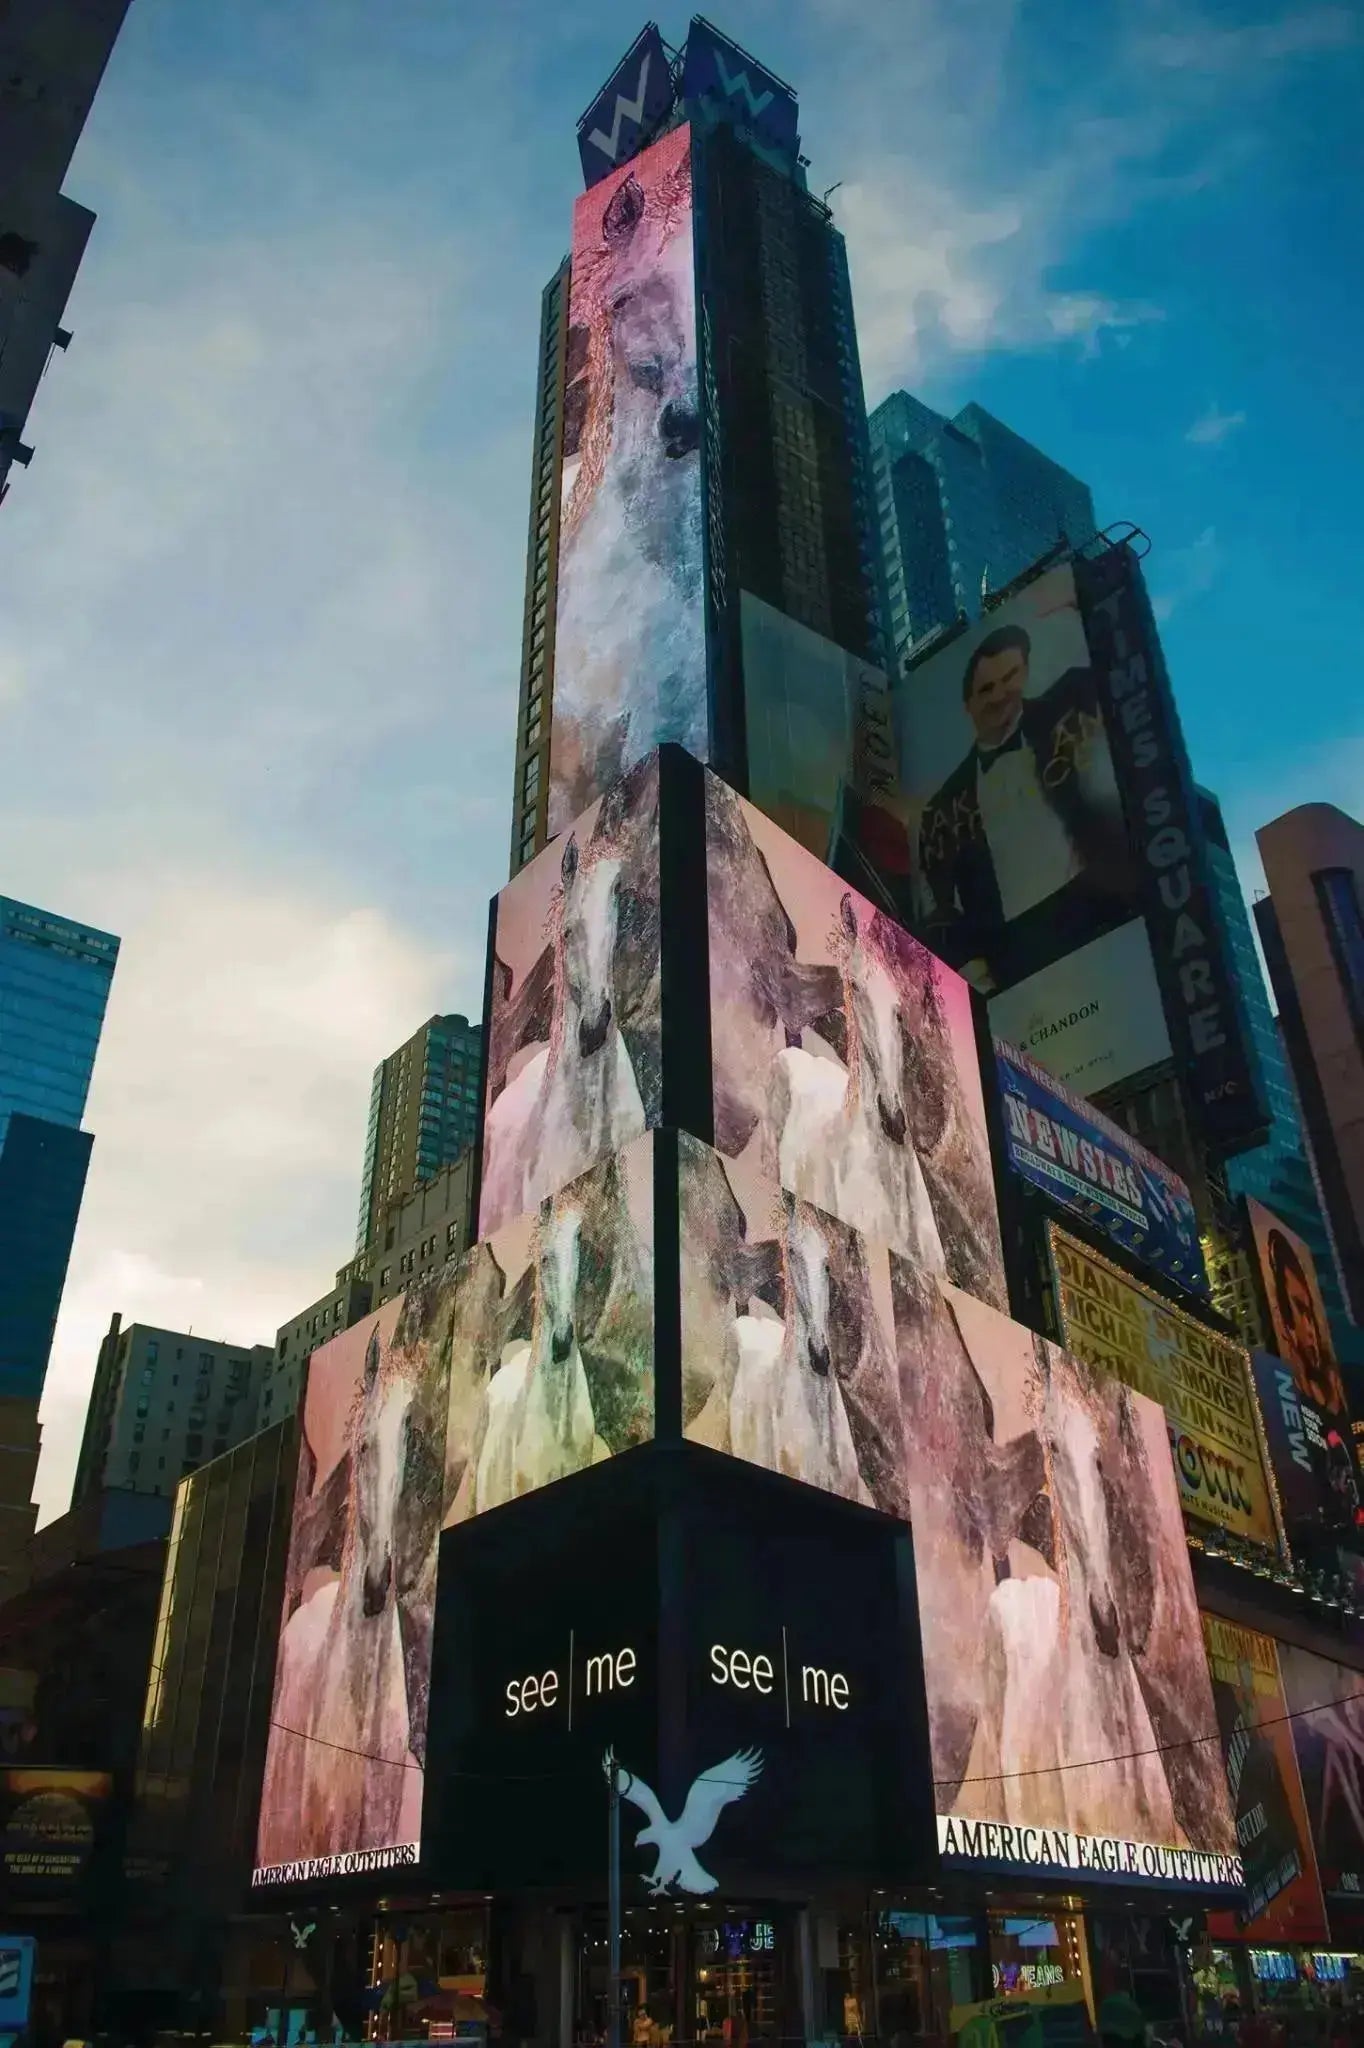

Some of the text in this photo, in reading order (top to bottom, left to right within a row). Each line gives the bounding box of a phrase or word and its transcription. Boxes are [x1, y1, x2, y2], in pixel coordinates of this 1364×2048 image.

[587, 51, 651, 161] W
[1093, 586, 1226, 1053] TIMES SQUARE
[1030, 999, 1100, 1045] CHANDON
[1203, 1079, 1238, 1105] NYC
[1003, 1093, 1143, 1208] NEWSIES
[1170, 1353, 1246, 1418] SMOKEY
[1274, 1368, 1312, 1473] NEW
[506, 1647, 637, 1717] see me
[710, 1644, 850, 1710] see me
[253, 1844, 416, 1887] AMERICAN EAGLE OUTFITTERS
[944, 1818, 1071, 1868] AMERICAN
[1076, 1836, 1138, 1874] EAGLE
[1142, 1845, 1245, 1887] OUTFITTERS
